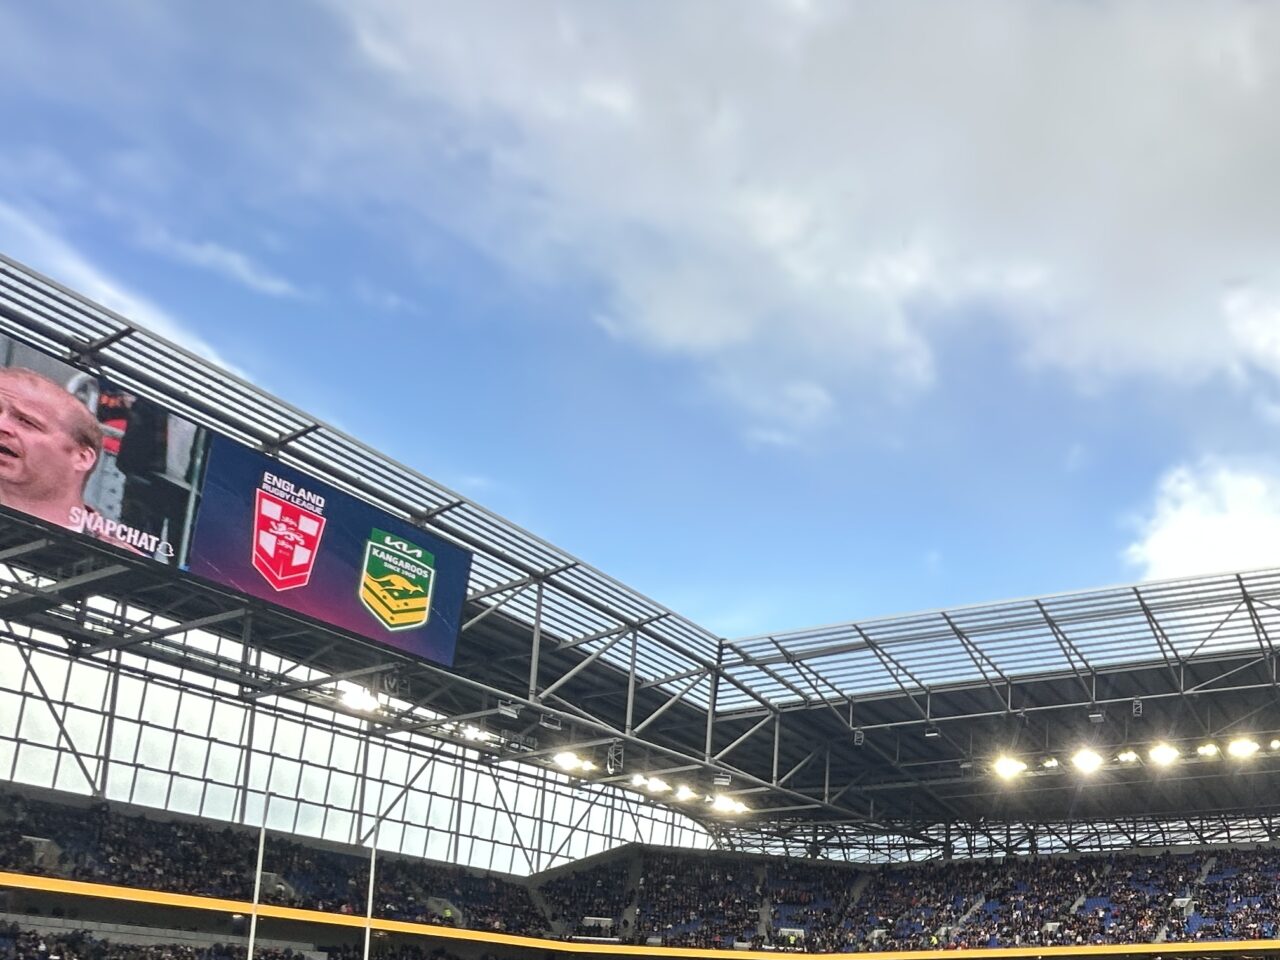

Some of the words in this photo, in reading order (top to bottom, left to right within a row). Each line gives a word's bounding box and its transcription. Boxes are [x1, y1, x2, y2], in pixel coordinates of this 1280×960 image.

[262, 482, 291, 501] RUGBY
[290, 494, 323, 515] LEAGUE
[263, 471, 326, 508] ENGLAND
[68, 506, 160, 552] SNAPCHAT
[372, 548, 429, 578] KANGAROOS
